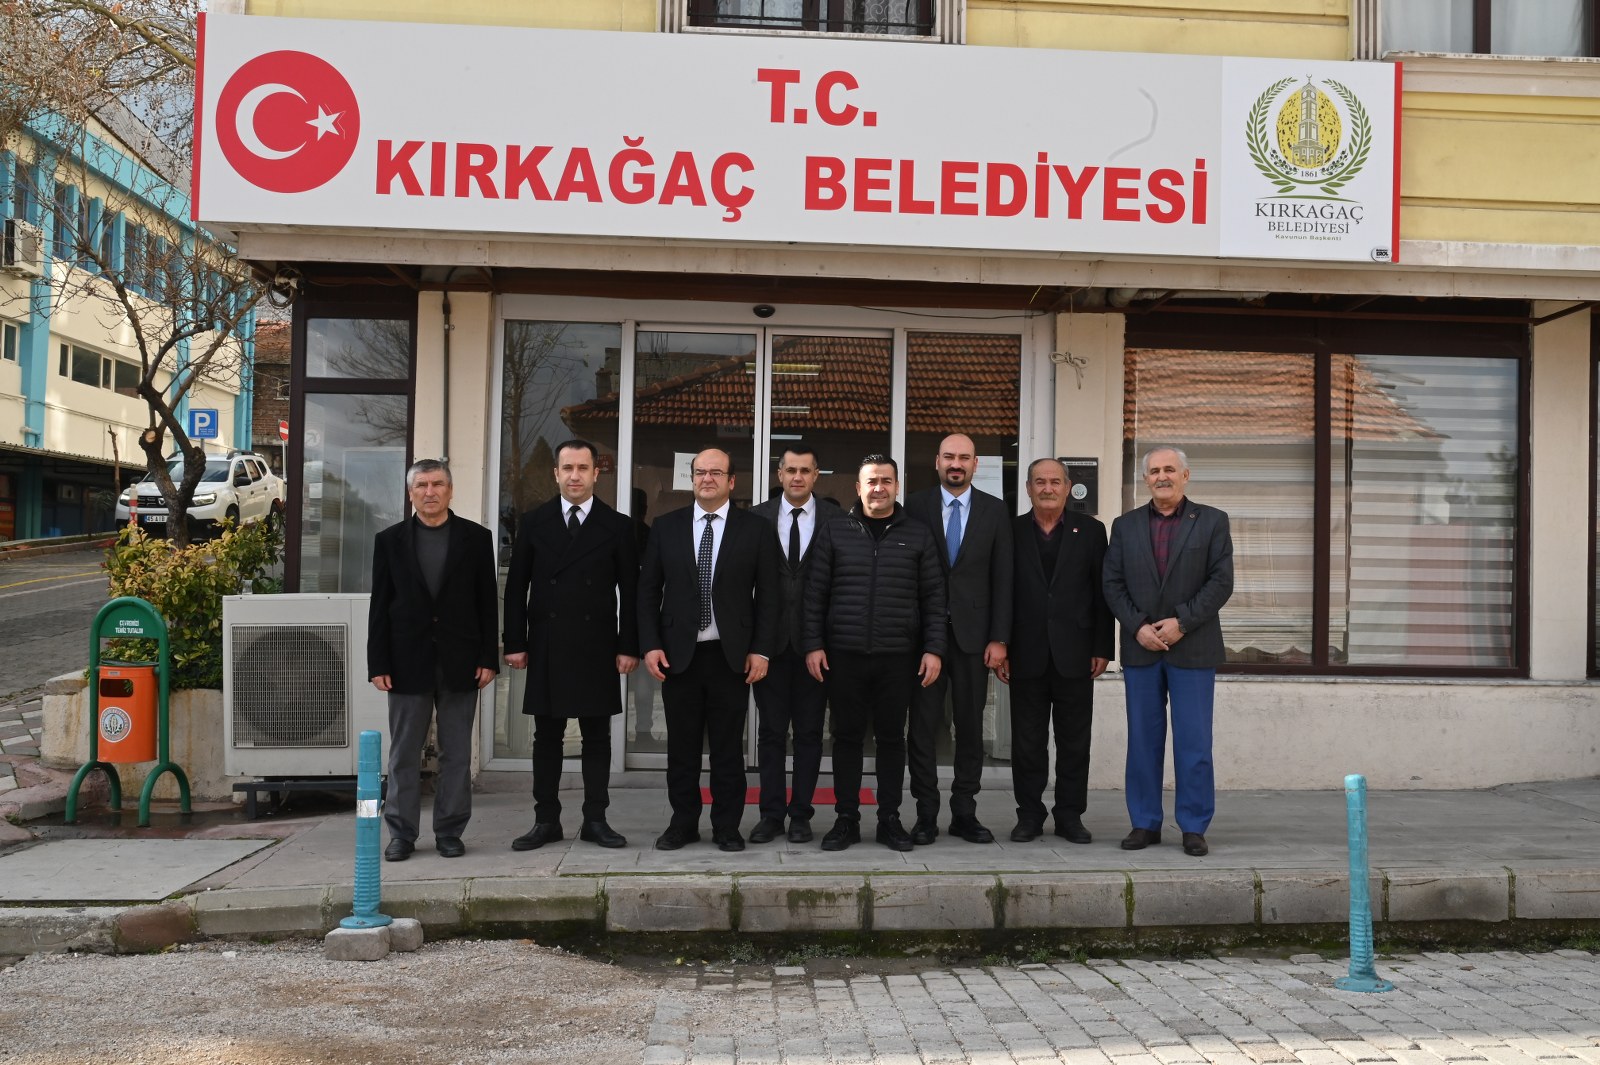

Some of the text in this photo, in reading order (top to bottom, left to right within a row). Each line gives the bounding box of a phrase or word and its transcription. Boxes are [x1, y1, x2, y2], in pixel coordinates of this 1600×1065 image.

[757, 68, 877, 127] T.C.
[376, 135, 1208, 225] KIRKAĞAÇ BELEDİYESİ
[1300, 170, 1318, 178] 1861
[1254, 202, 1364, 225] KIRKAĞAÇ
[1267, 220, 1350, 234] BELEDİYESİ
[1309, 234, 1342, 242] Başkenti
[194, 412, 211, 436] P
